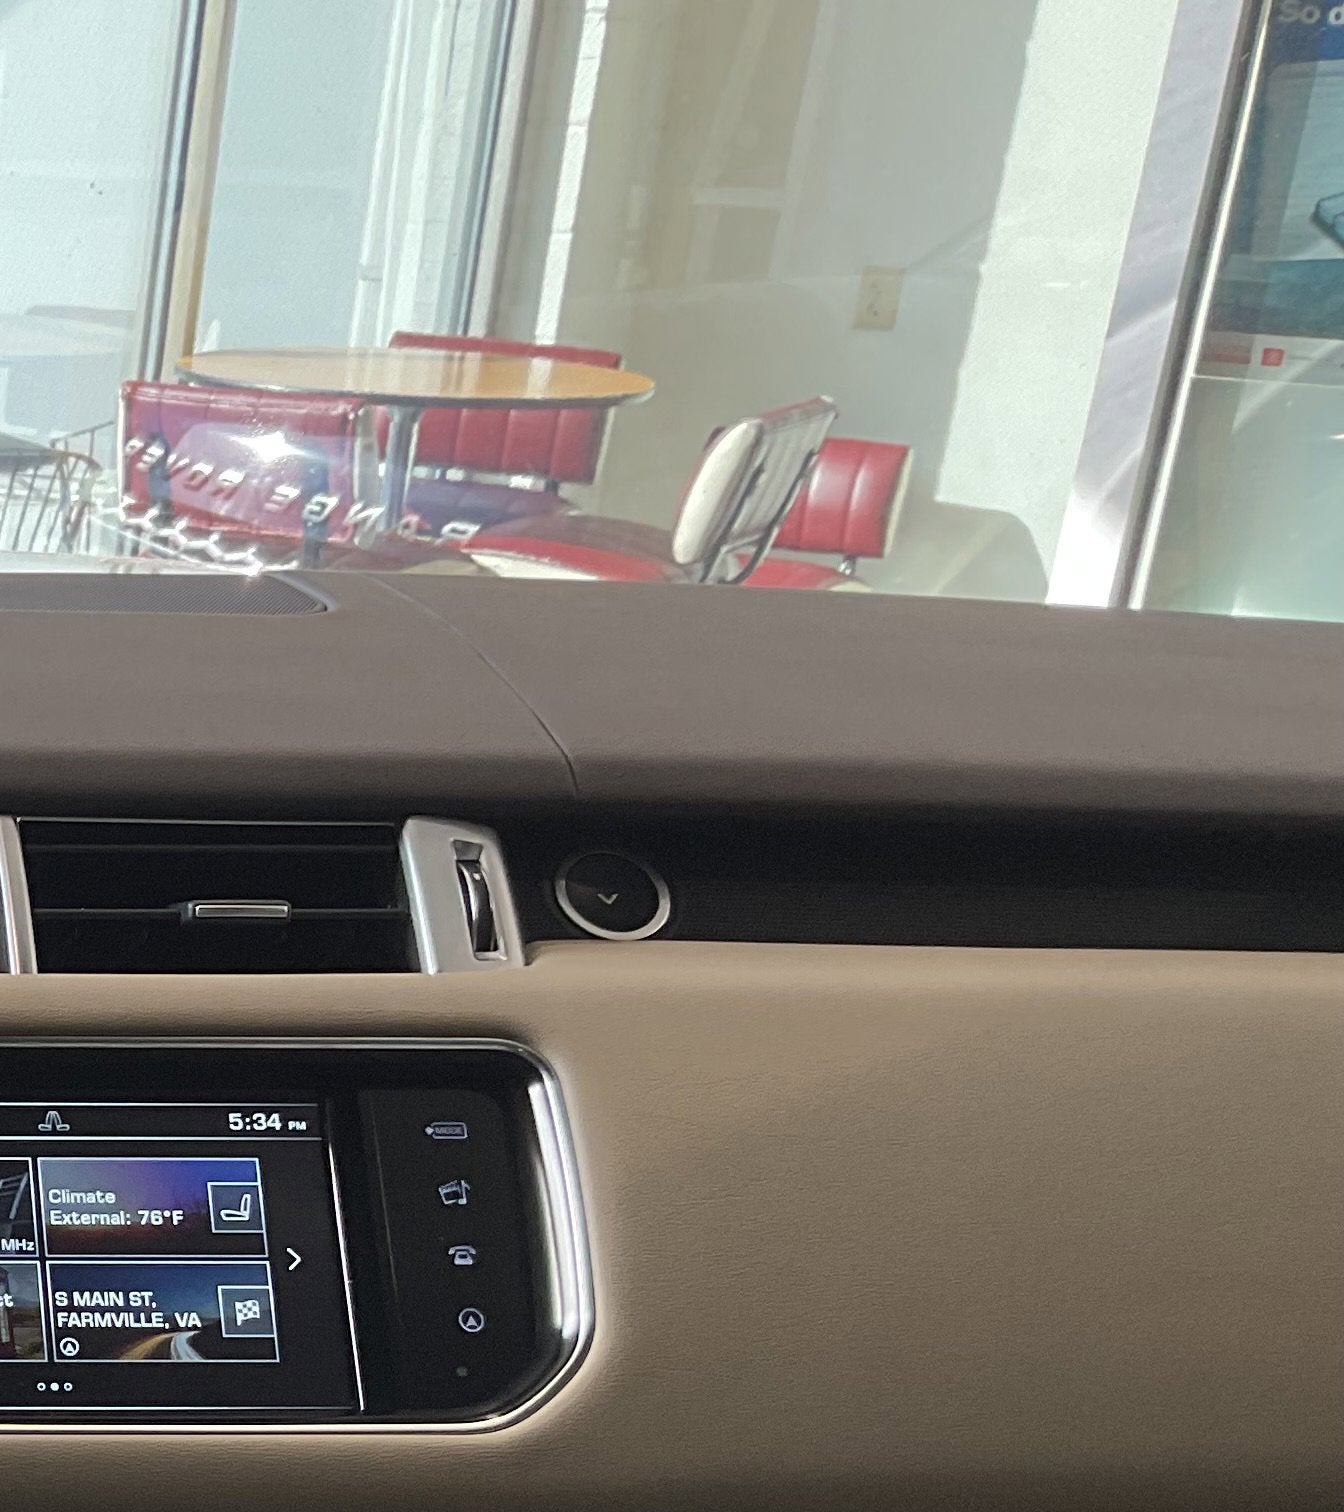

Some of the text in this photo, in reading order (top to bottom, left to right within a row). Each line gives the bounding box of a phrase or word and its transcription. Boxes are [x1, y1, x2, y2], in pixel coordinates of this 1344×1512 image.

[227, 1112, 307, 1131] 5:34 PM
[48, 1189, 116, 1204] Climate
[50, 1210, 184, 1226] External: 76°F
[1, 1238, 35, 1251] MHz
[54, 1291, 68, 1307] S
[72, 1291, 124, 1307] MAIN
[57, 1312, 202, 1329] FARMVILLE, VA
